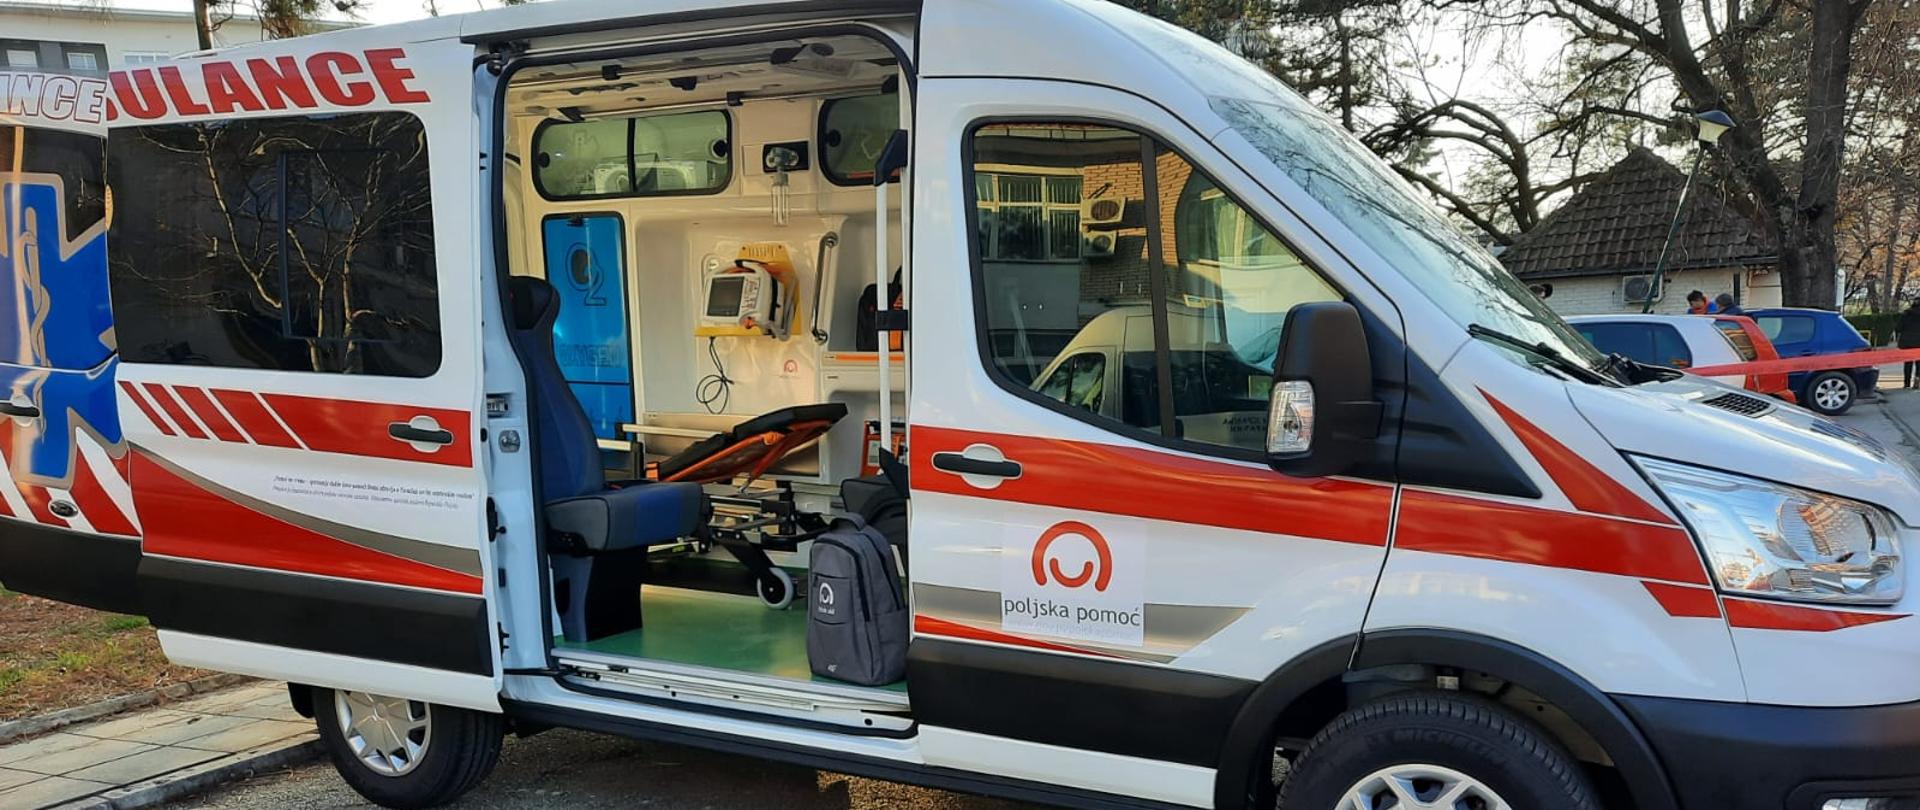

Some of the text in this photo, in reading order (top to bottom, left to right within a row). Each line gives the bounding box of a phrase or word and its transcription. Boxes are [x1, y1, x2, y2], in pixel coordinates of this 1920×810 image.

[106, 47, 431, 121] ULANCE
[1004, 597, 1141, 627] poljska pomoć
